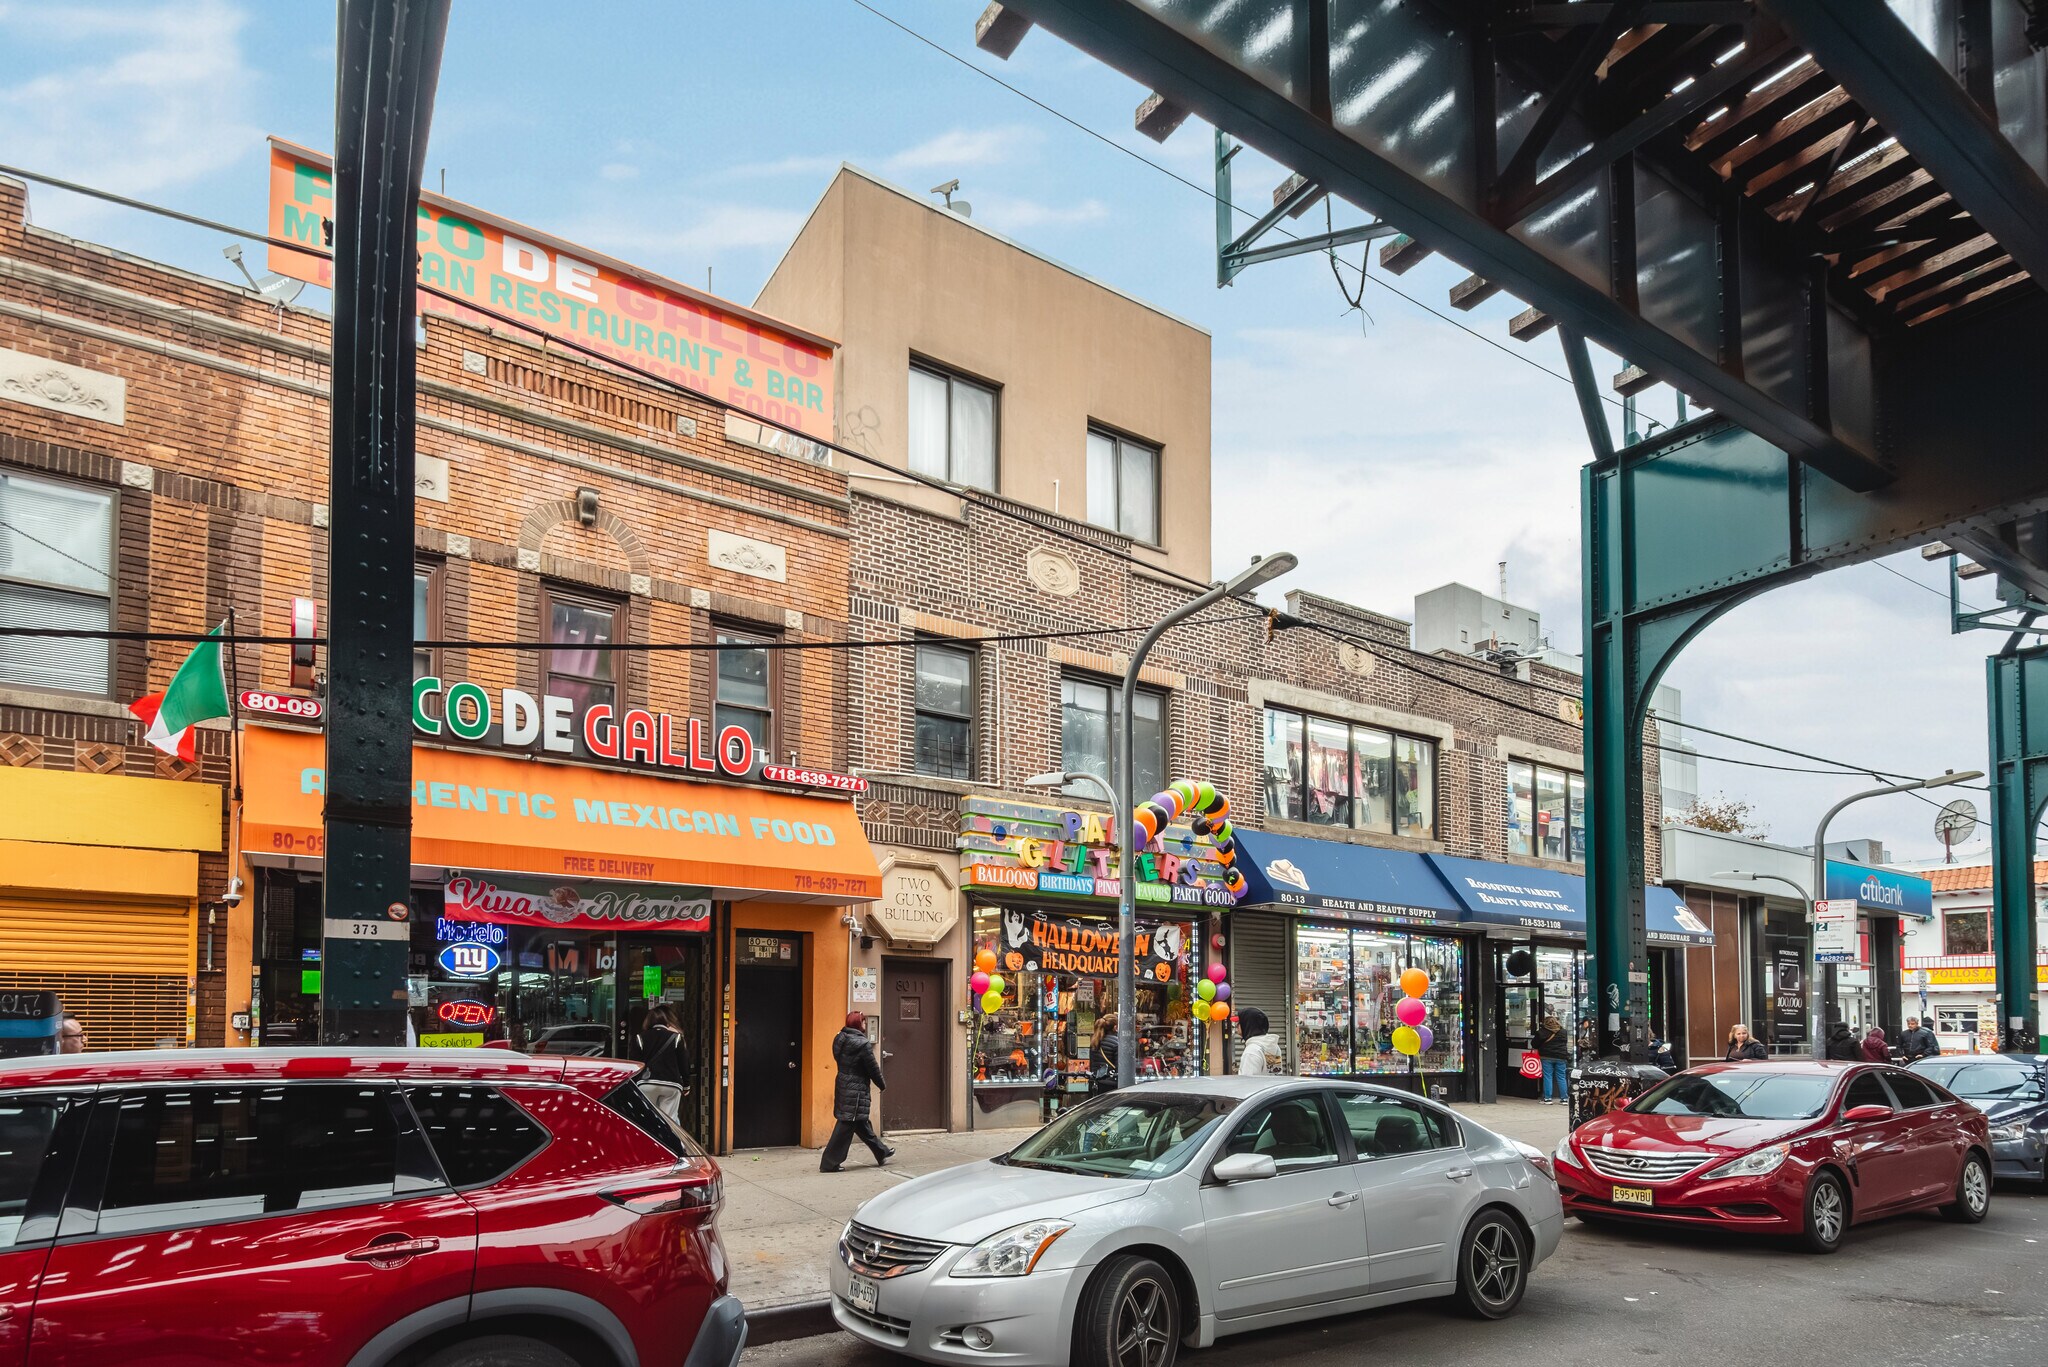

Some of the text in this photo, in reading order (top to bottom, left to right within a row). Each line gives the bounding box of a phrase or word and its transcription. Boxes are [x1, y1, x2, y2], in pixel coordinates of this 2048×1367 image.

[502, 234, 599, 303] DE
[615, 277, 819, 379] GALLO
[490, 273, 722, 377] RESTAURANT
[734, 358, 753, 389] &
[767, 369, 824, 414] BAR
[248, 694, 317, 716] 80-09
[502, 688, 573, 753] DE
[584, 704, 753, 776] GALLO
[767, 765, 865, 790] 718-639-7271
[573, 799, 740, 837] MEXICAN
[750, 816, 836, 846] FOOD
[564, 857, 654, 877] FREE DELIVERY
[978, 866, 1036, 887] BALLOONS
[795, 875, 867, 893] 718-639-7271
[898, 877, 930, 891] TWO
[1041, 875, 1093, 893] BIRTHDAYS
[1138, 884, 1170, 900] FAVORS
[1174, 886, 1202, 902] PARTY
[1860, 880, 1904, 906] citibank
[449, 876, 707, 922] Viva México
[895, 892, 932, 908] GUYS
[1281, 893, 1437, 918] 80-13 HEALTH AND BEAUTY SUPPLY
[885, 908, 943, 924] BUILDING
[1520, 918, 1561, 929] 718-533-1108
[1818, 922, 1826, 931] 2
[353, 924, 378, 935] 373
[437, 917, 503, 944] Modelo
[1033, 919, 1150, 956] HALLOWEN
[1647, 931, 1658, 939] AND
[1659, 933, 1690, 942] HOUSEWARE
[749, 937, 778, 946] 80-09
[452, 948, 488, 972] ny
[1042, 951, 1140, 976] HEADQUARTS
[1932, 969, 1980, 978] POLLOS
[439, 1002, 494, 1024] OPEN
